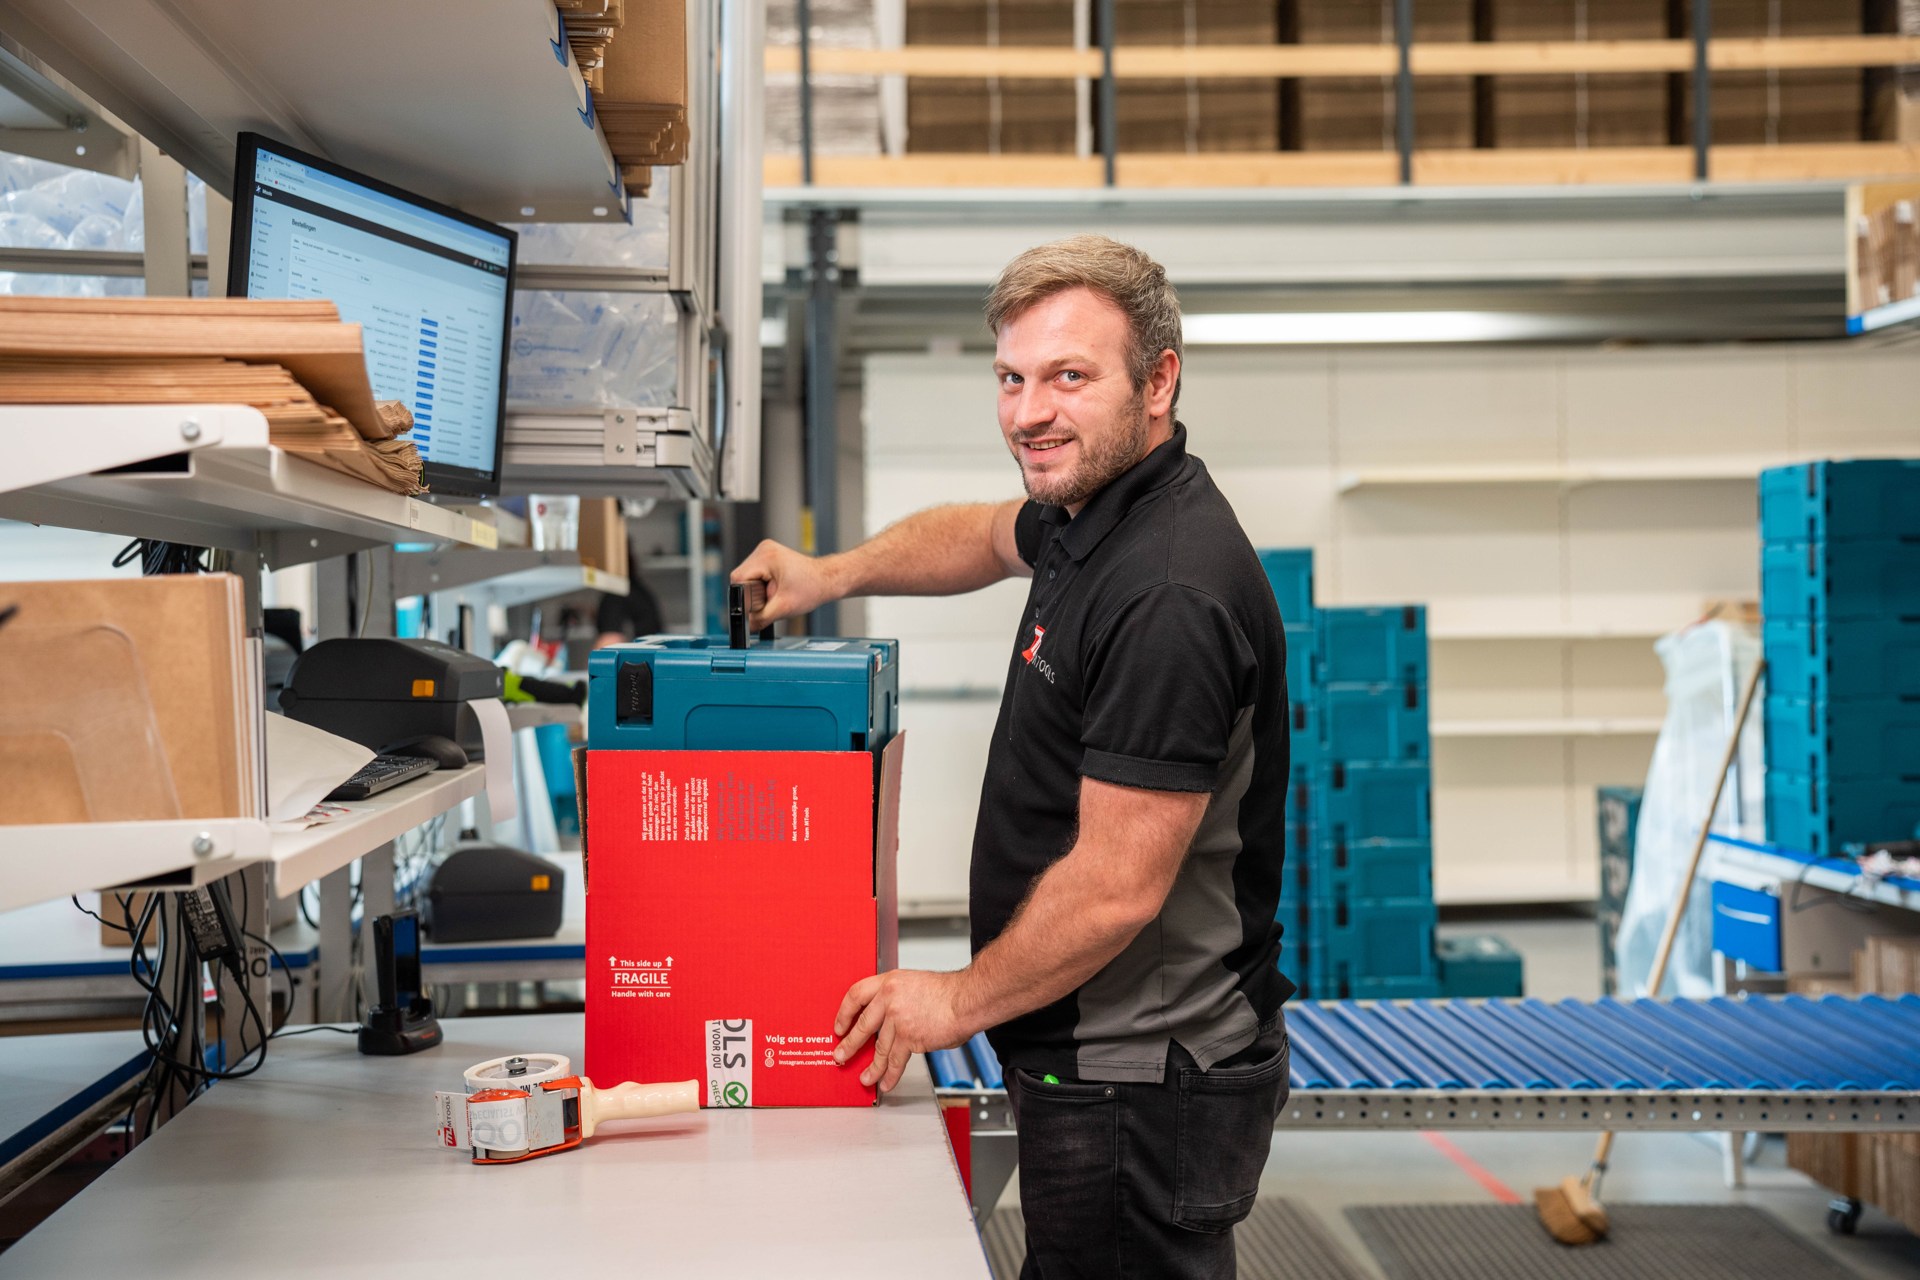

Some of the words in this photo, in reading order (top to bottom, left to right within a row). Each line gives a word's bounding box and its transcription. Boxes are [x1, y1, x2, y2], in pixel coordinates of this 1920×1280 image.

[614, 972, 668, 984] FRAGILE
[712, 1028, 721, 1051] VOOR
[765, 1035, 786, 1045] Volg
[806, 1035, 832, 1043] overal
[711, 1053, 722, 1069] JOU
